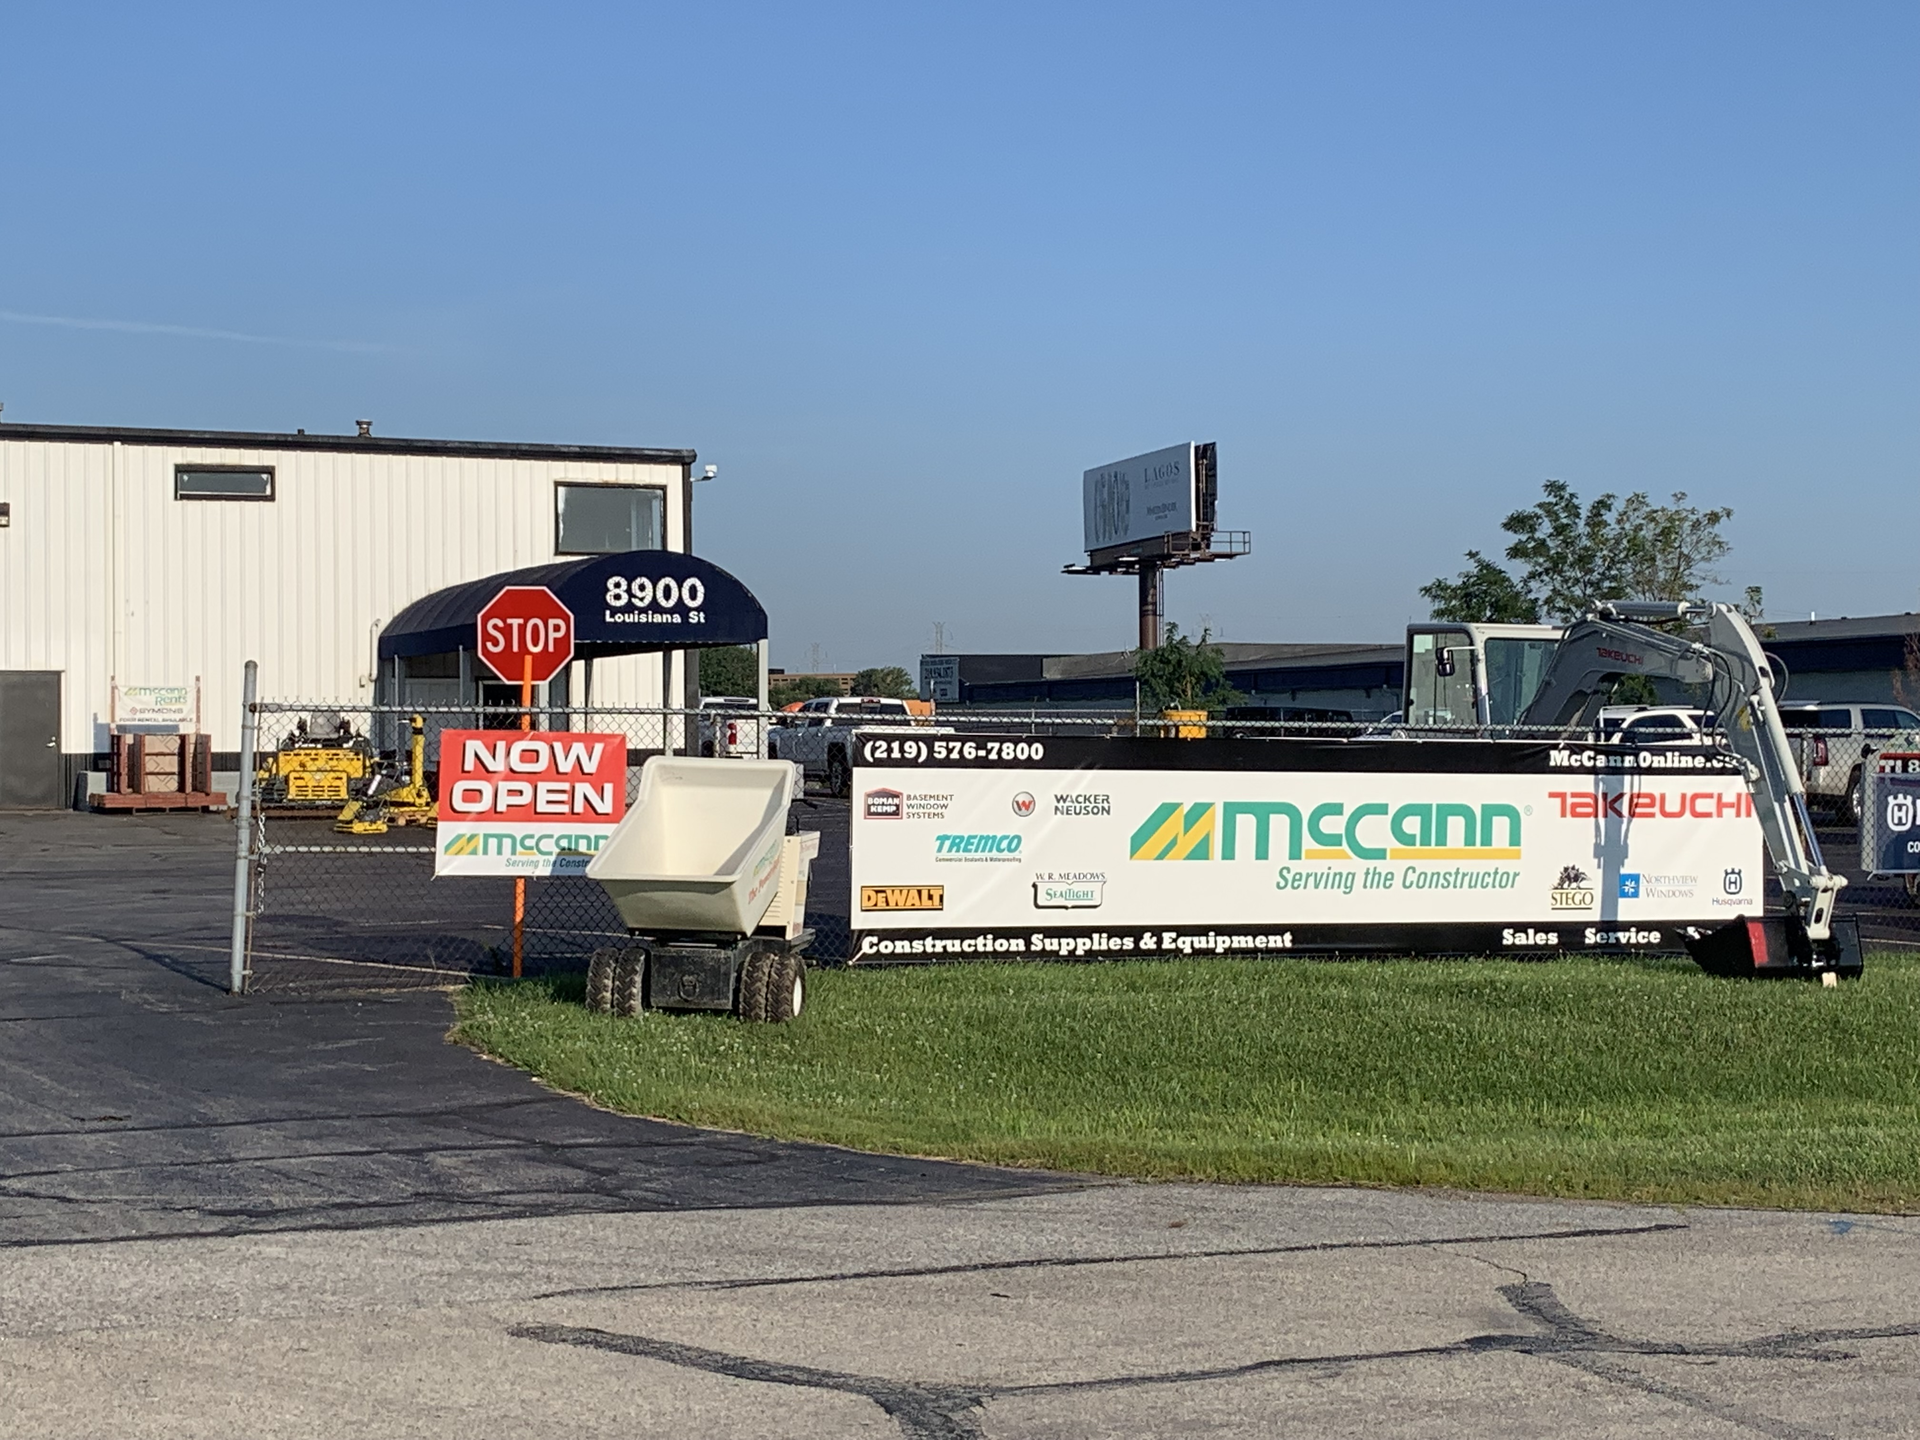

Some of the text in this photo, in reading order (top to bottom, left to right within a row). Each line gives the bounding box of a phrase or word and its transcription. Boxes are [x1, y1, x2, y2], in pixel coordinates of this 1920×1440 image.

[1144, 461, 1180, 483] LAGOS
[605, 576, 705, 608] 8900
[605, 610, 706, 624] Louisiana St
[485, 618, 567, 653] STOP
[462, 740, 605, 776] NOW
[863, 741, 1044, 762] (219) 576-7800
[451, 780, 614, 815] OPEN
[867, 797, 900, 805] BOMAN
[906, 794, 954, 802] BASEMENT
[1053, 794, 1111, 804] WACKER
[1053, 805, 1111, 816] NEUSON
[935, 834, 1023, 853] TREMCO
[505, 858, 540, 870] Serving
[542, 858, 557, 868] the
[1058, 872, 1106, 881] MEADOWS
[1275, 866, 1520, 895] Serving the Constructor
[1641, 874, 1699, 884] NORTHVIEW
[1551, 892, 1594, 906] STEGO
[1645, 887, 1694, 898] WINDOWS
[1712, 898, 1753, 906] Husqvarna
[861, 931, 1293, 956] Construction Supplies & Equipment
[1502, 927, 1662, 946] Sales Service
